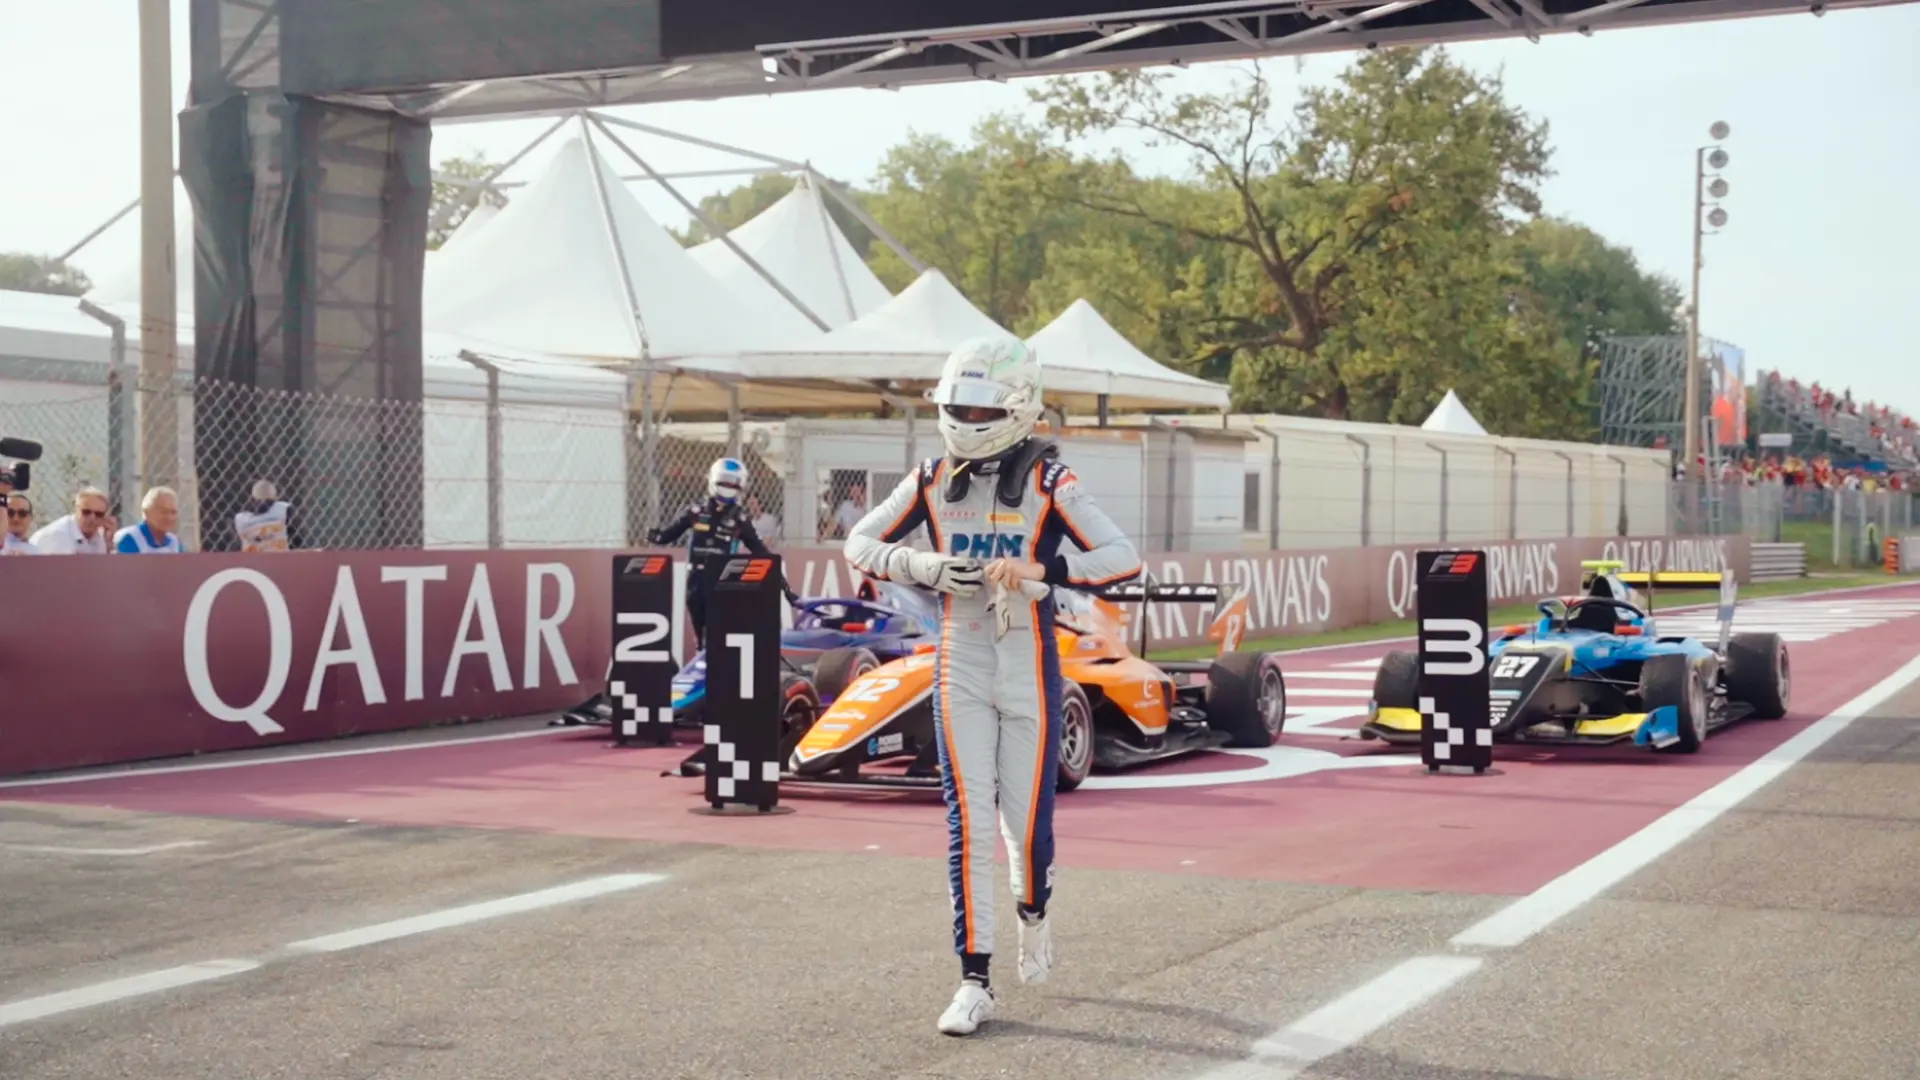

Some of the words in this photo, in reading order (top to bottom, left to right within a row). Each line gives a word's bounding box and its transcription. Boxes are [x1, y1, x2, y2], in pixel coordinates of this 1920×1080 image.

[951, 532, 1025, 559] PHM
[1602, 540, 1662, 572] QATAR
[624, 557, 667, 575] F3
[719, 559, 773, 581] F3
[1429, 553, 1479, 574] F3
[1484, 542, 1559, 600] RWAYS
[183, 562, 579, 736] QATAR
[615, 612, 670, 662] 2
[1422, 618, 1485, 676] 3
[725, 633, 755, 699] 1
[1493, 656, 1540, 678] 27
[844, 677, 900, 703] 12
